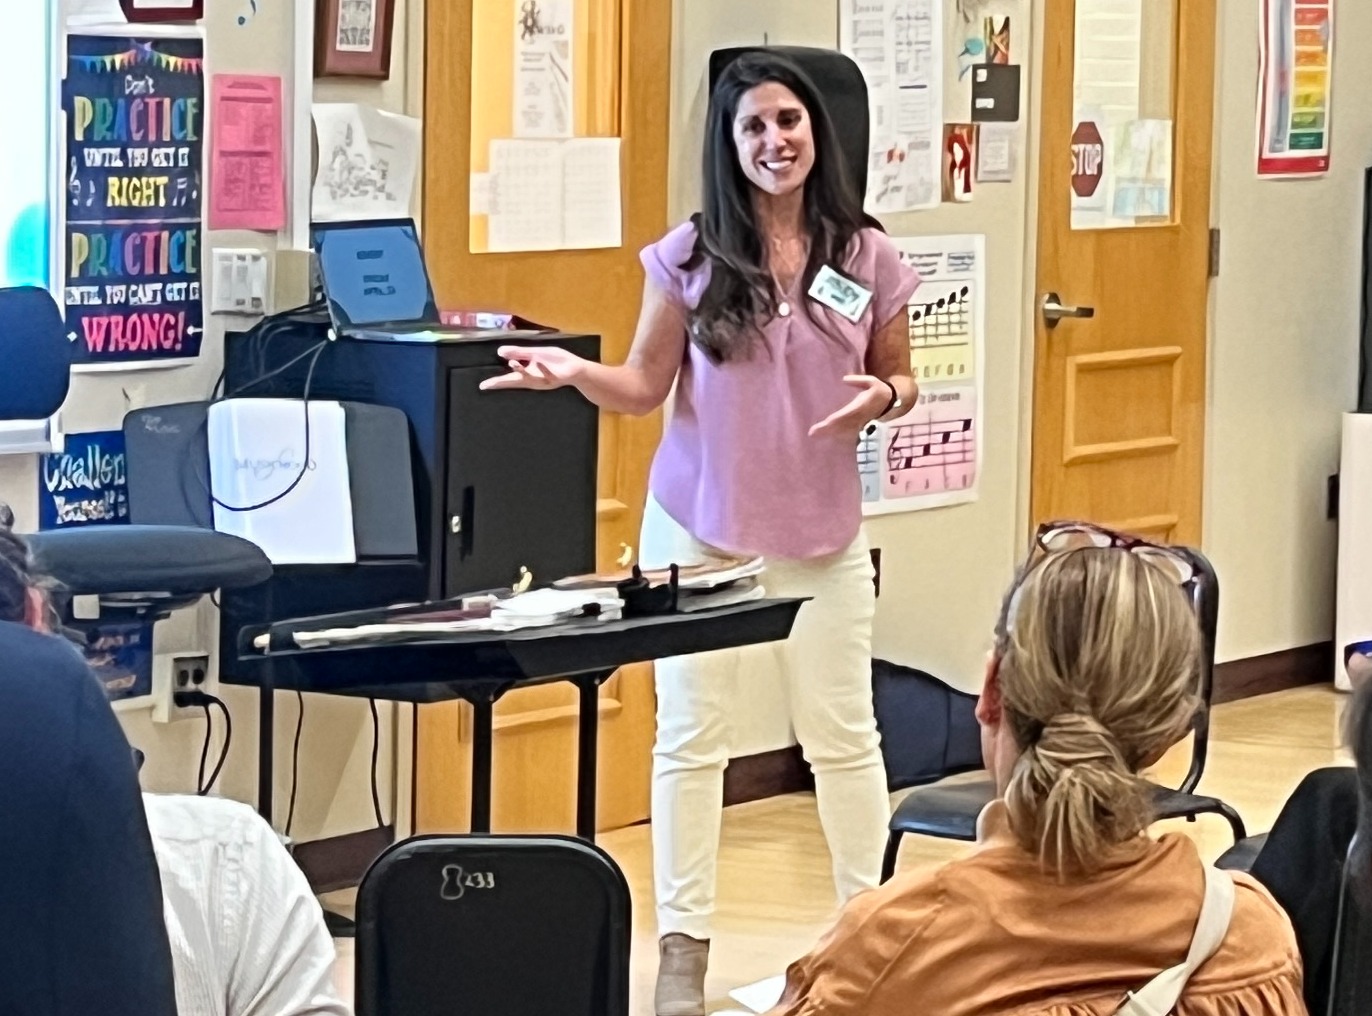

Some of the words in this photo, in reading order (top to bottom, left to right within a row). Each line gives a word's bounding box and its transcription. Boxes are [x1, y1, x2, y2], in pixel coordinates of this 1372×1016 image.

[74, 96, 199, 141] PRACTICE
[107, 176, 169, 207] RIGHT
[71, 229, 197, 278] PRACTICE
[82, 311, 185, 352] WRONG!
[44, 444, 125, 492] Challen
